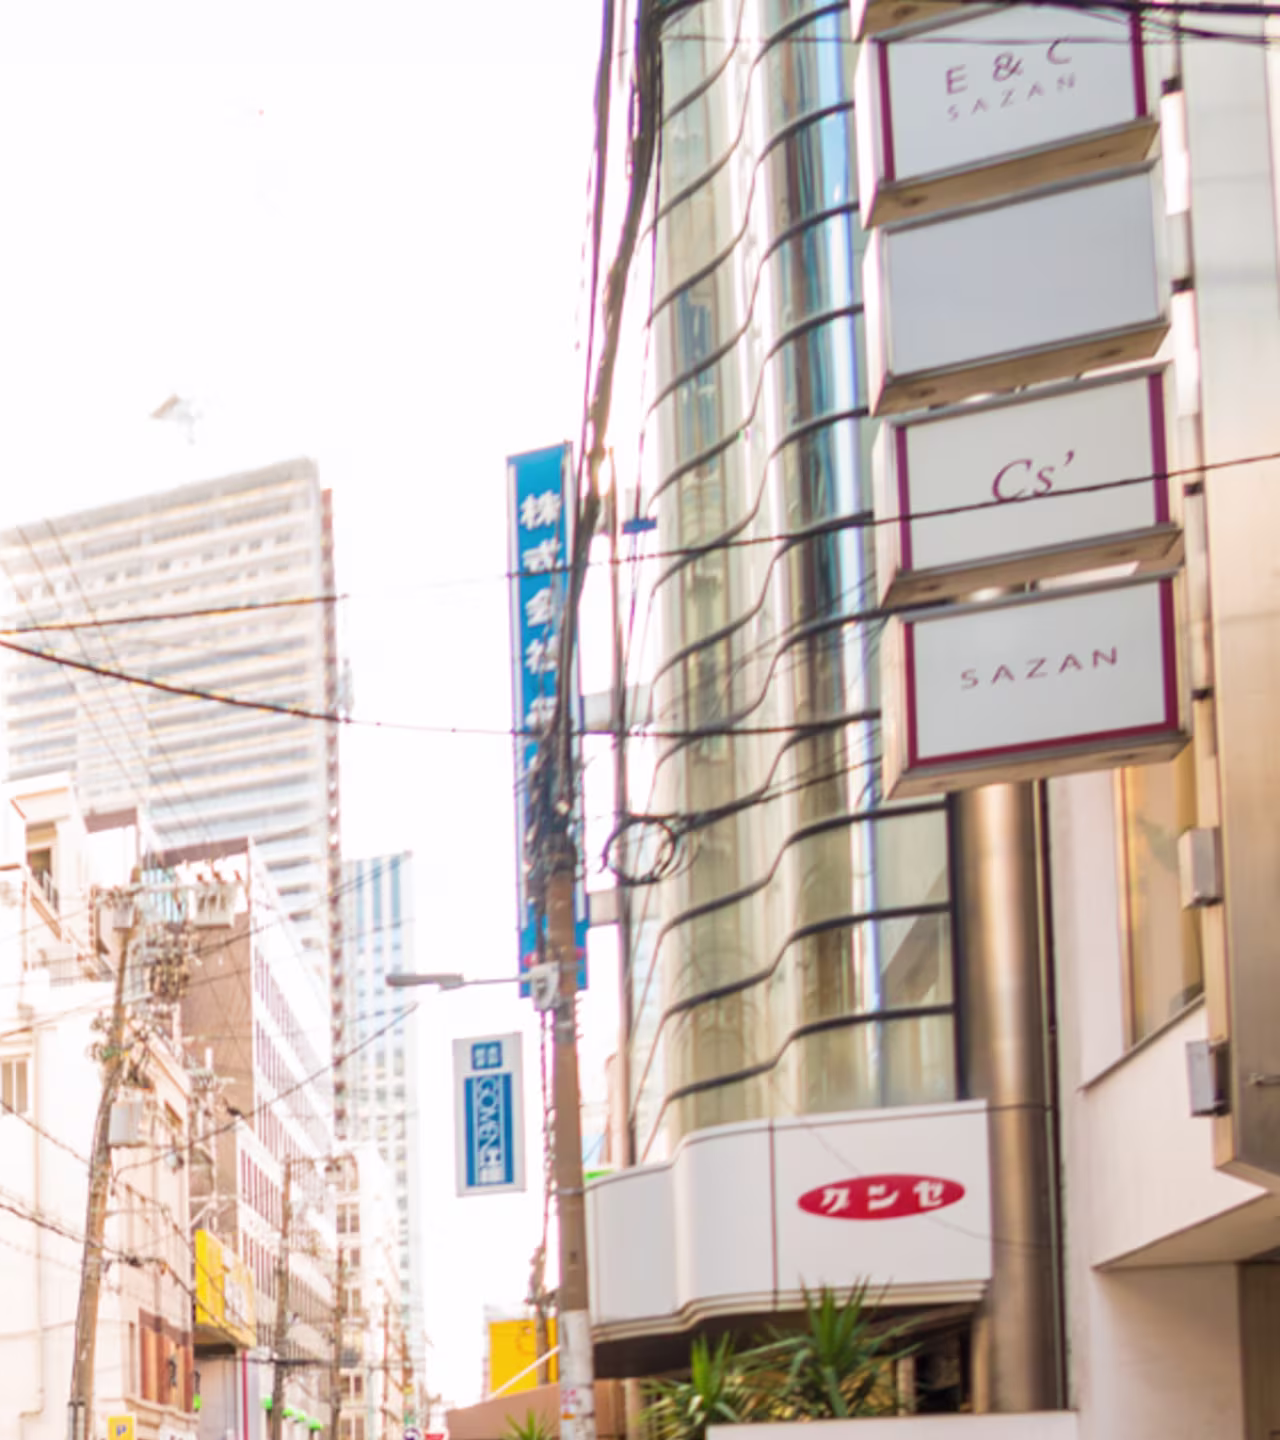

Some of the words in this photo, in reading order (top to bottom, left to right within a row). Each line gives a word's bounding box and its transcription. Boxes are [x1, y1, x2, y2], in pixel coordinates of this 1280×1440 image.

[946, 63, 969, 96] E
[992, 51, 1023, 82] &
[1046, 34, 1073, 65] C
[947, 72, 1076, 123] SAZAN
[959, 646, 1119, 691] SAZAN
